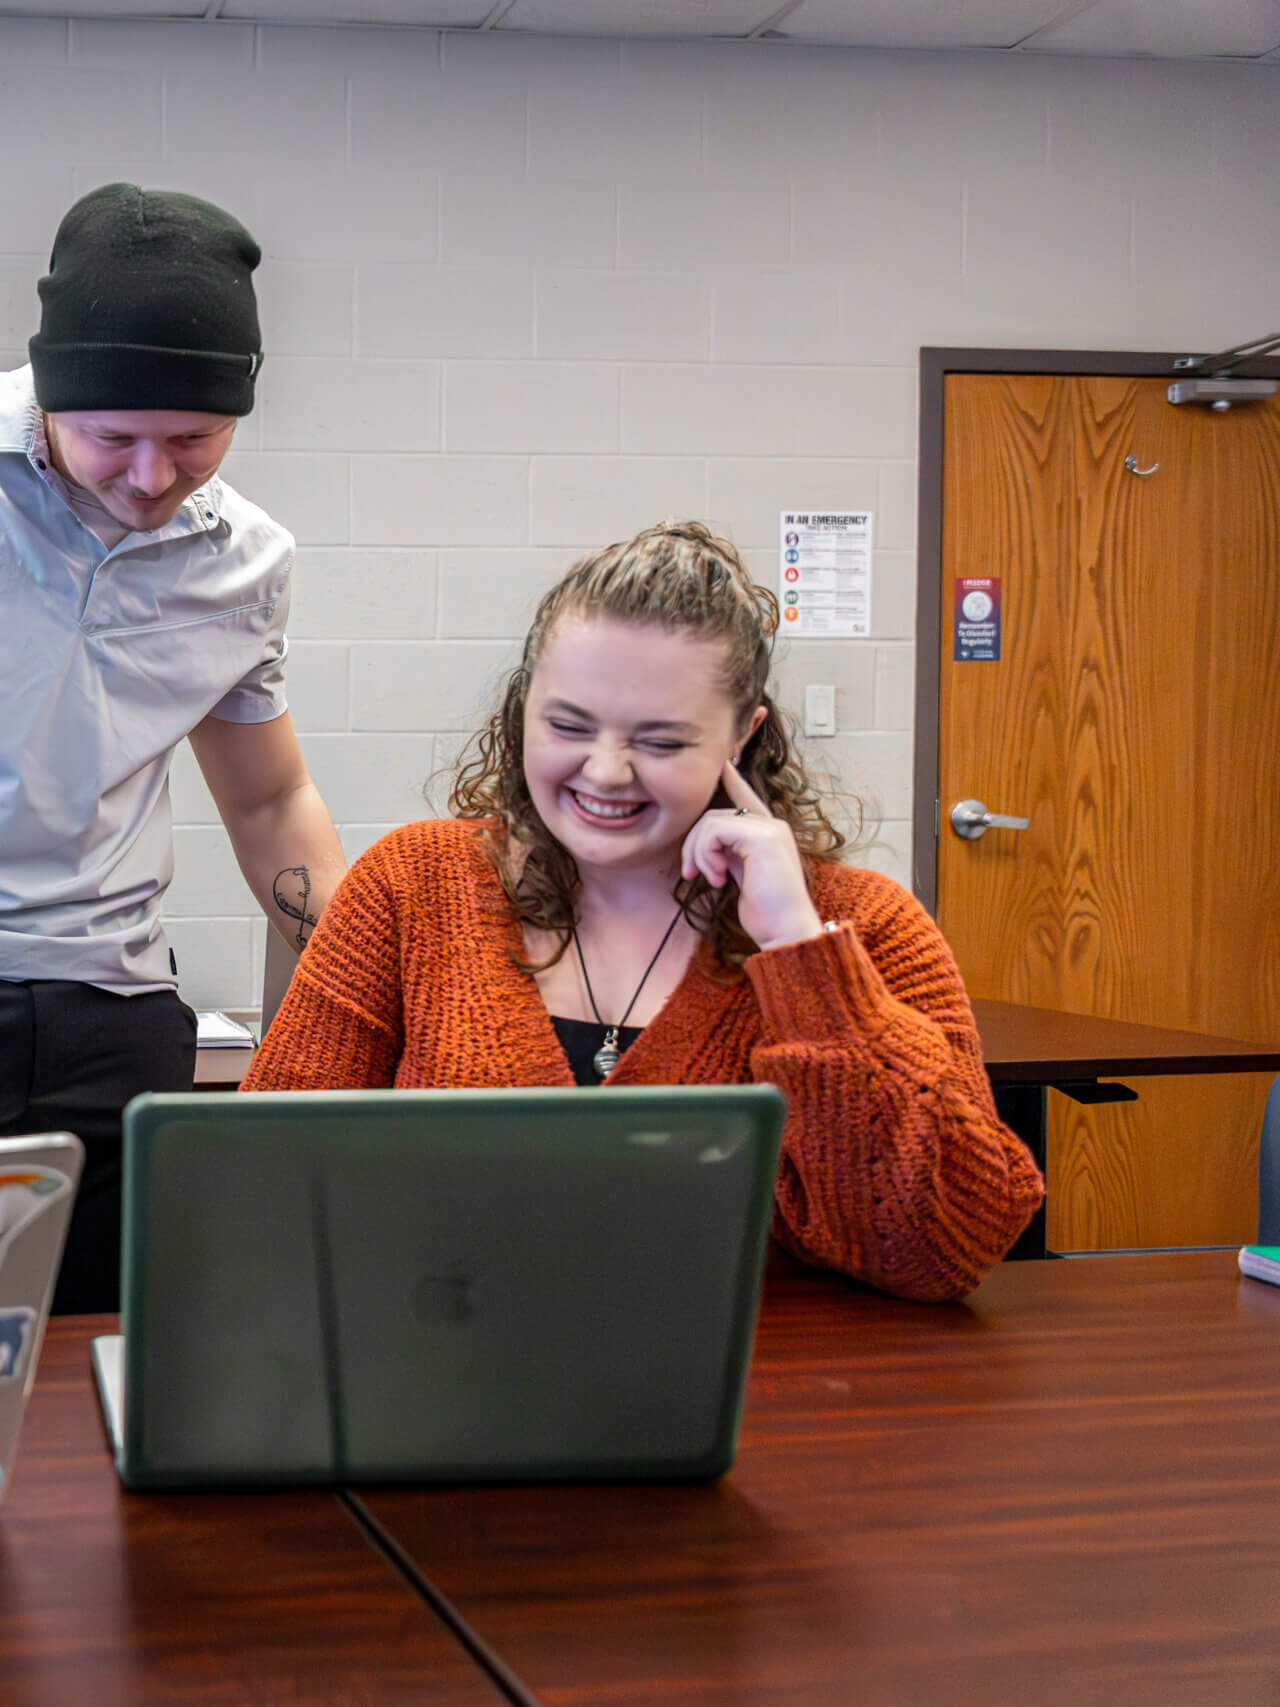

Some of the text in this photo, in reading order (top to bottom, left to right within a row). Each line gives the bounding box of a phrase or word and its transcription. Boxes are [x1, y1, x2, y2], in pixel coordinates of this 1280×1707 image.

[785, 515, 867, 525] IN AN EMERGENCY
